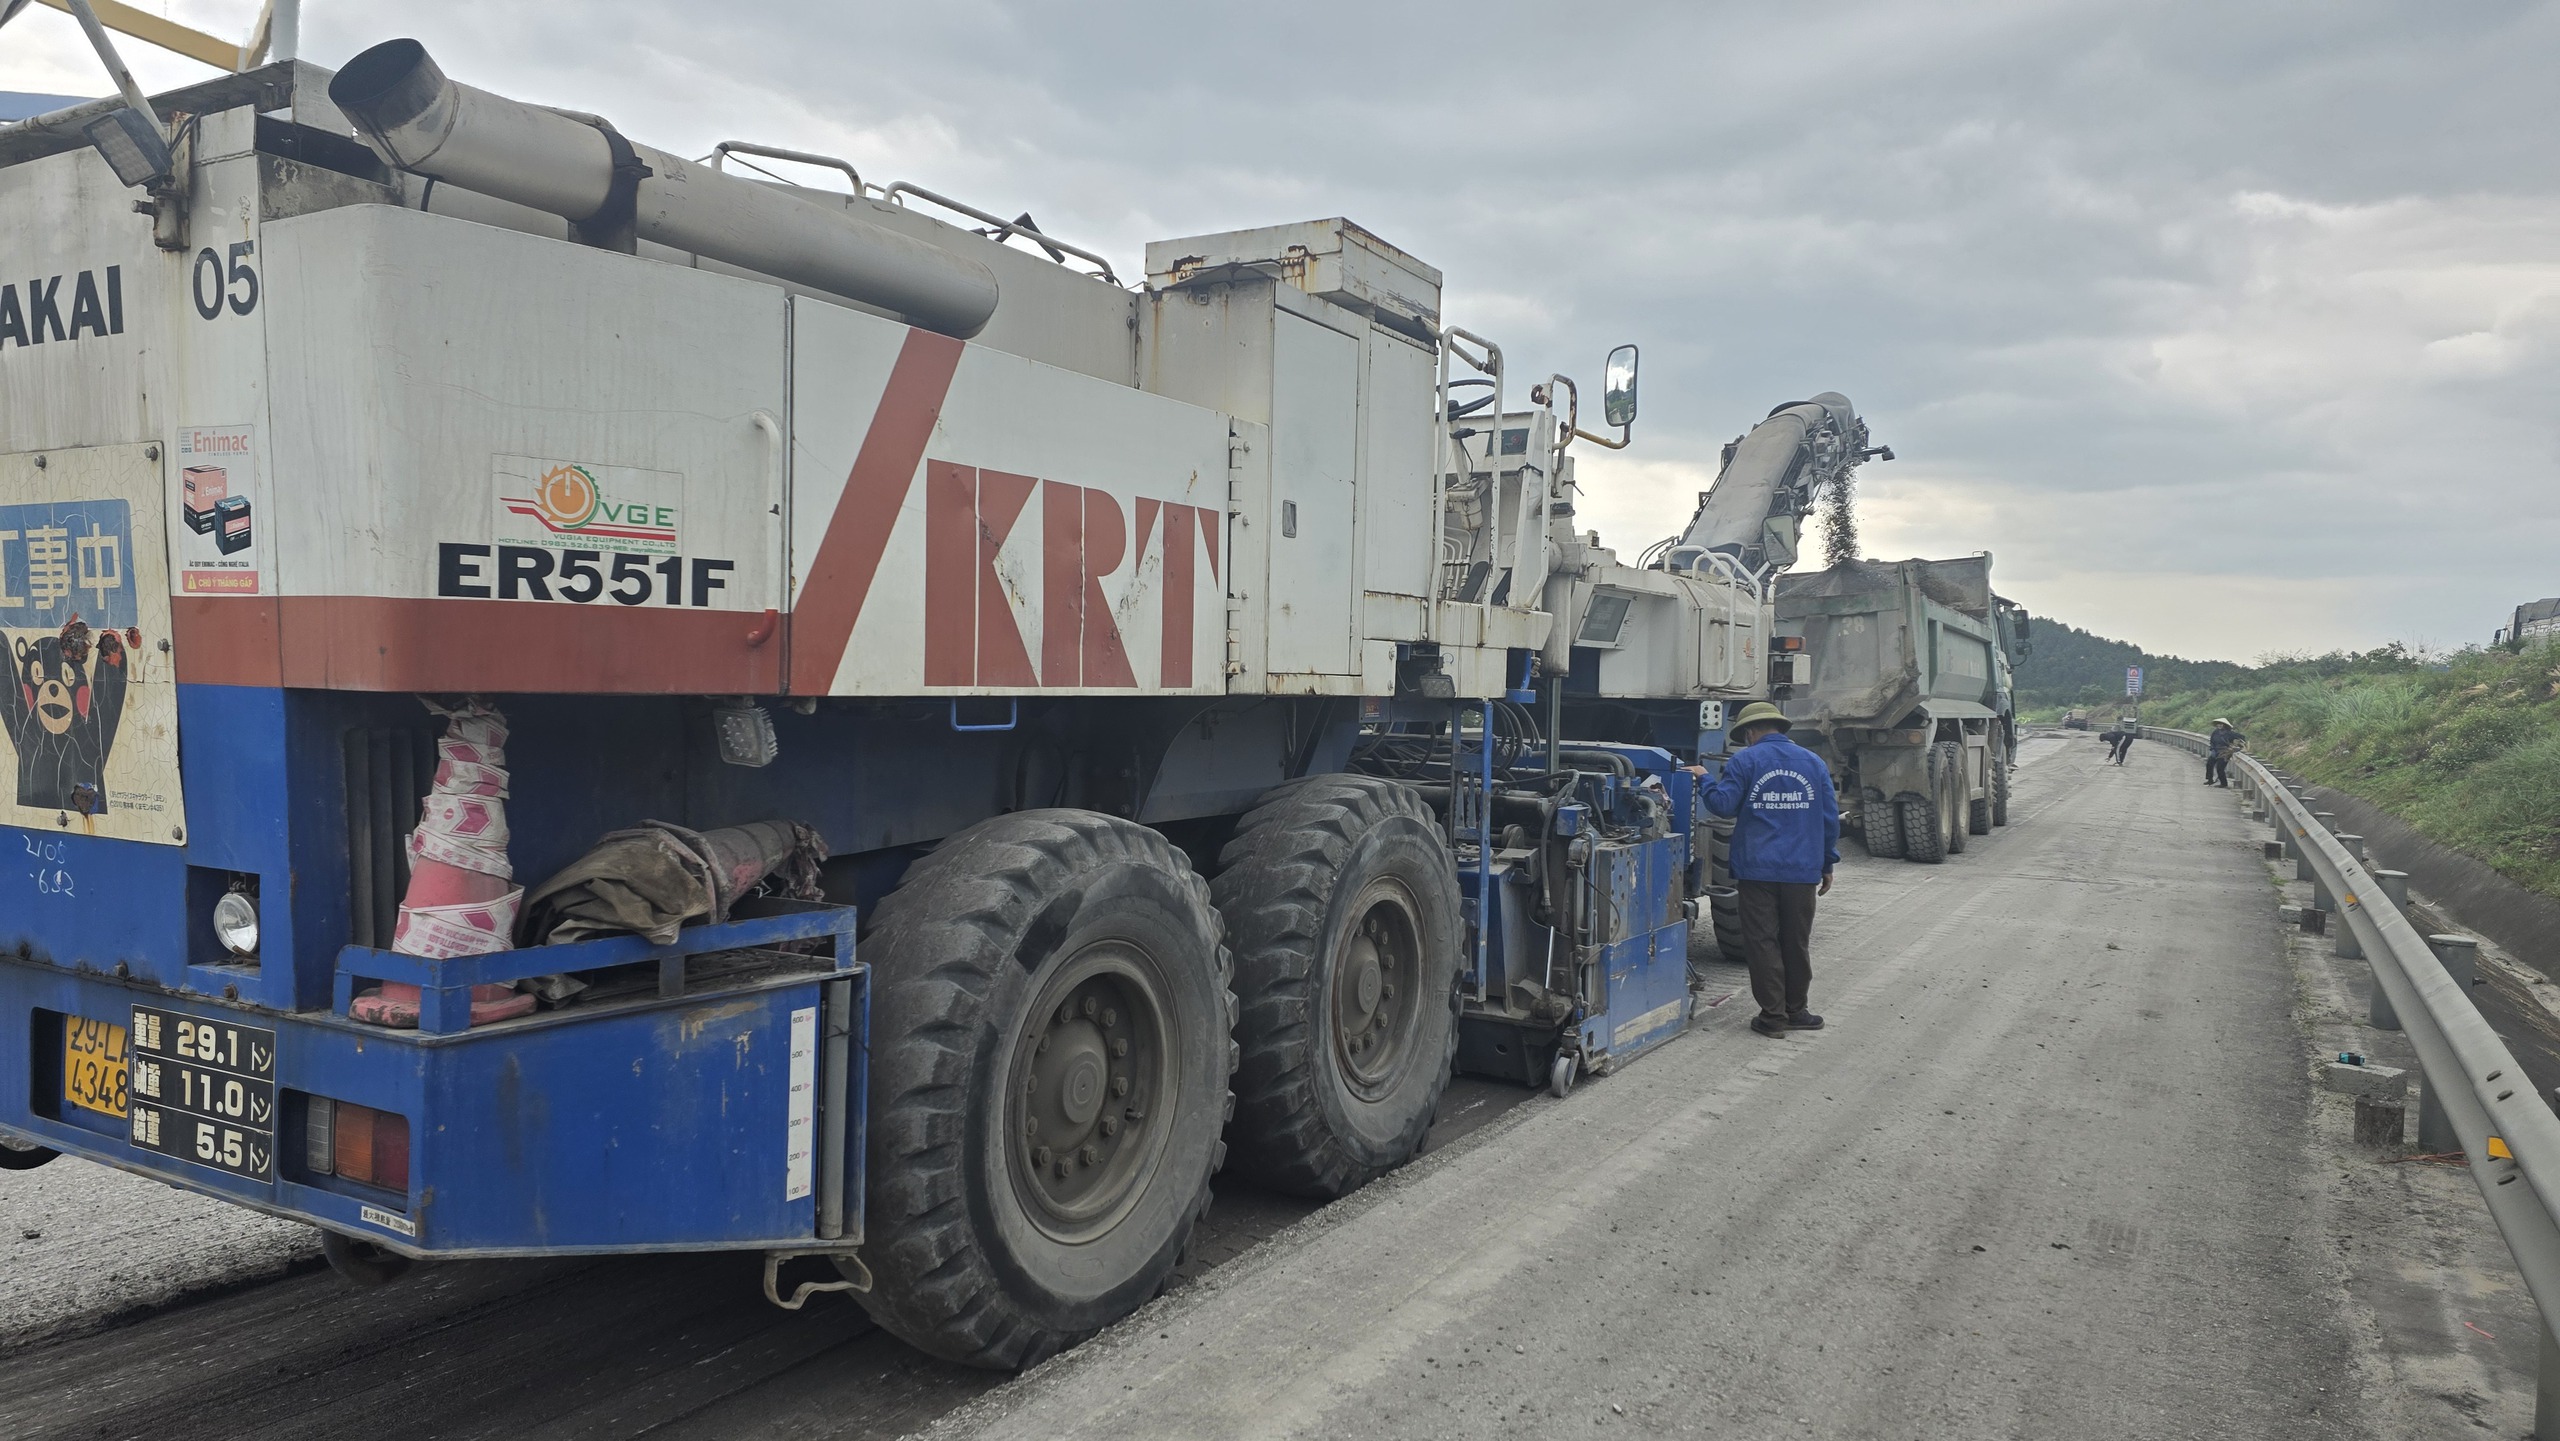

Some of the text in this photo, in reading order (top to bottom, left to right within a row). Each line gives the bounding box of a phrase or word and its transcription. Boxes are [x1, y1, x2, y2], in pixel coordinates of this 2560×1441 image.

[193, 240, 259, 321] 05
[194, 431, 248, 452] Enimac
[600, 502, 674, 527] VGE
[498, 538, 538, 546] HOTLINE:
[553, 533, 677, 548] VUGIA EQUIPMENT CO.,LTD
[438, 542, 734, 608] ER551F
[1781, 790, 1803, 801] PHÁT
[133, 1012, 272, 1072] 重量 29.1 トン
[72, 1058, 128, 1113] 4348
[181, 1070, 244, 1117] 11.0
[250, 1092, 272, 1123] トン
[791, 1084, 802, 1093] 400
[789, 1118, 801, 1128] 300
[133, 1106, 271, 1174] 輪重 5.5 トン
[788, 1152, 800, 1162] 200
